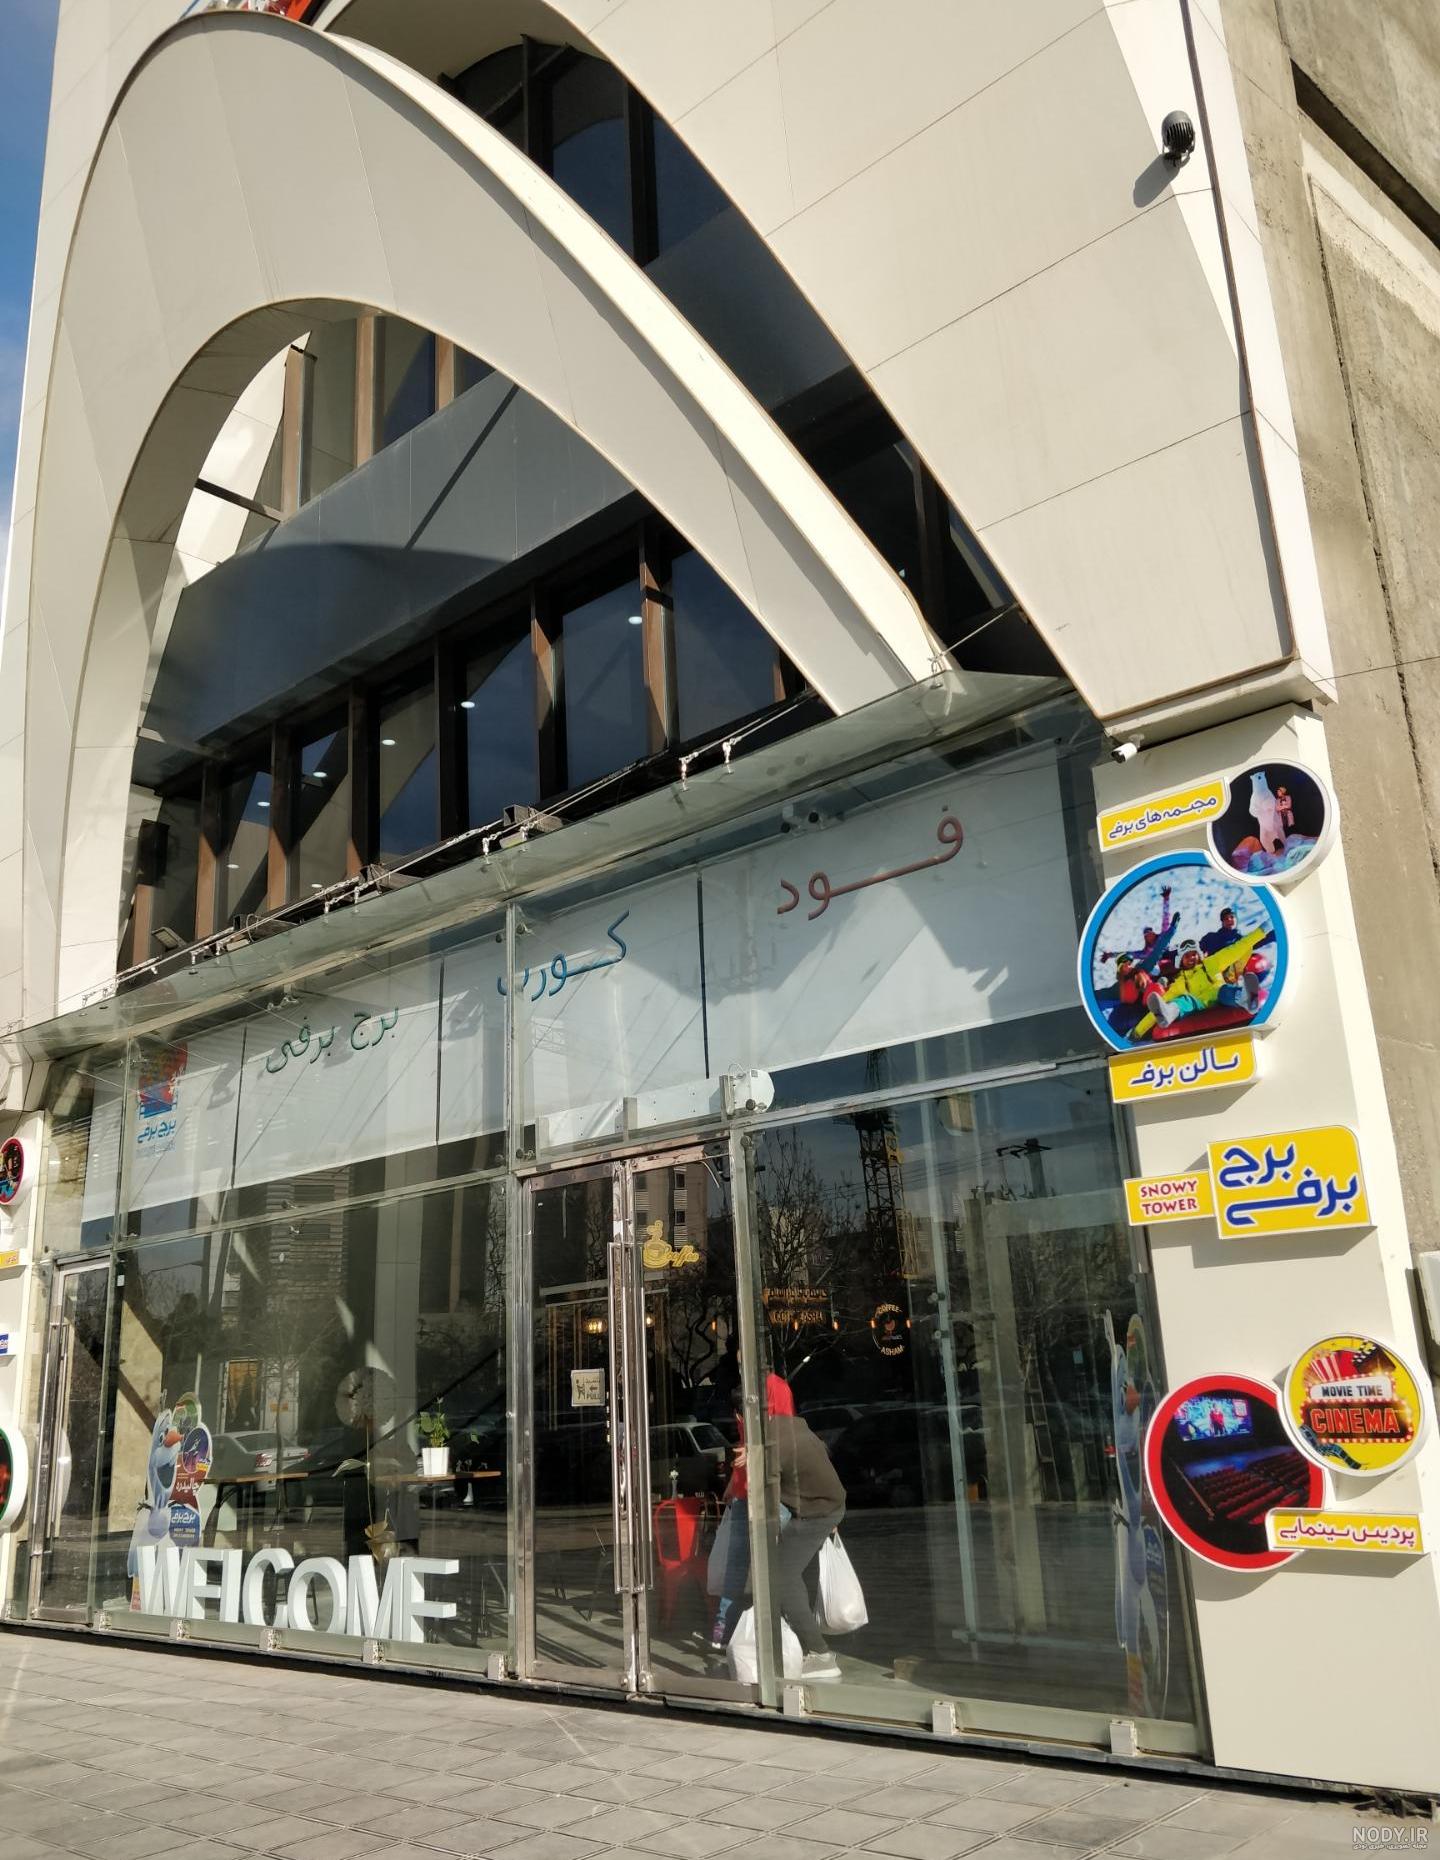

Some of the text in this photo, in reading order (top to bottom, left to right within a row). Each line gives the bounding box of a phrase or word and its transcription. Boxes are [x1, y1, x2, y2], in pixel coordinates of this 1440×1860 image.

[1108, 821, 1134, 839] برفی
[776, 804, 964, 921] فود
[265, 1006, 399, 1074] برج برفی
[1130, 1046, 1239, 1088] سالن برف
[1219, 1143, 1296, 1188] برج
[1140, 1180, 1198, 1198] SNOWY
[1141, 1198, 1198, 1215] TOWER
[1225, 1168, 1358, 1226] برفی
[1321, 1385, 1383, 1397] MOVIE TIME
[1310, 1407, 1400, 1434] CINEMA
[1279, 1517, 1415, 1547] پردیس سینمایی
[136, 1545, 460, 1643] WELCOME
